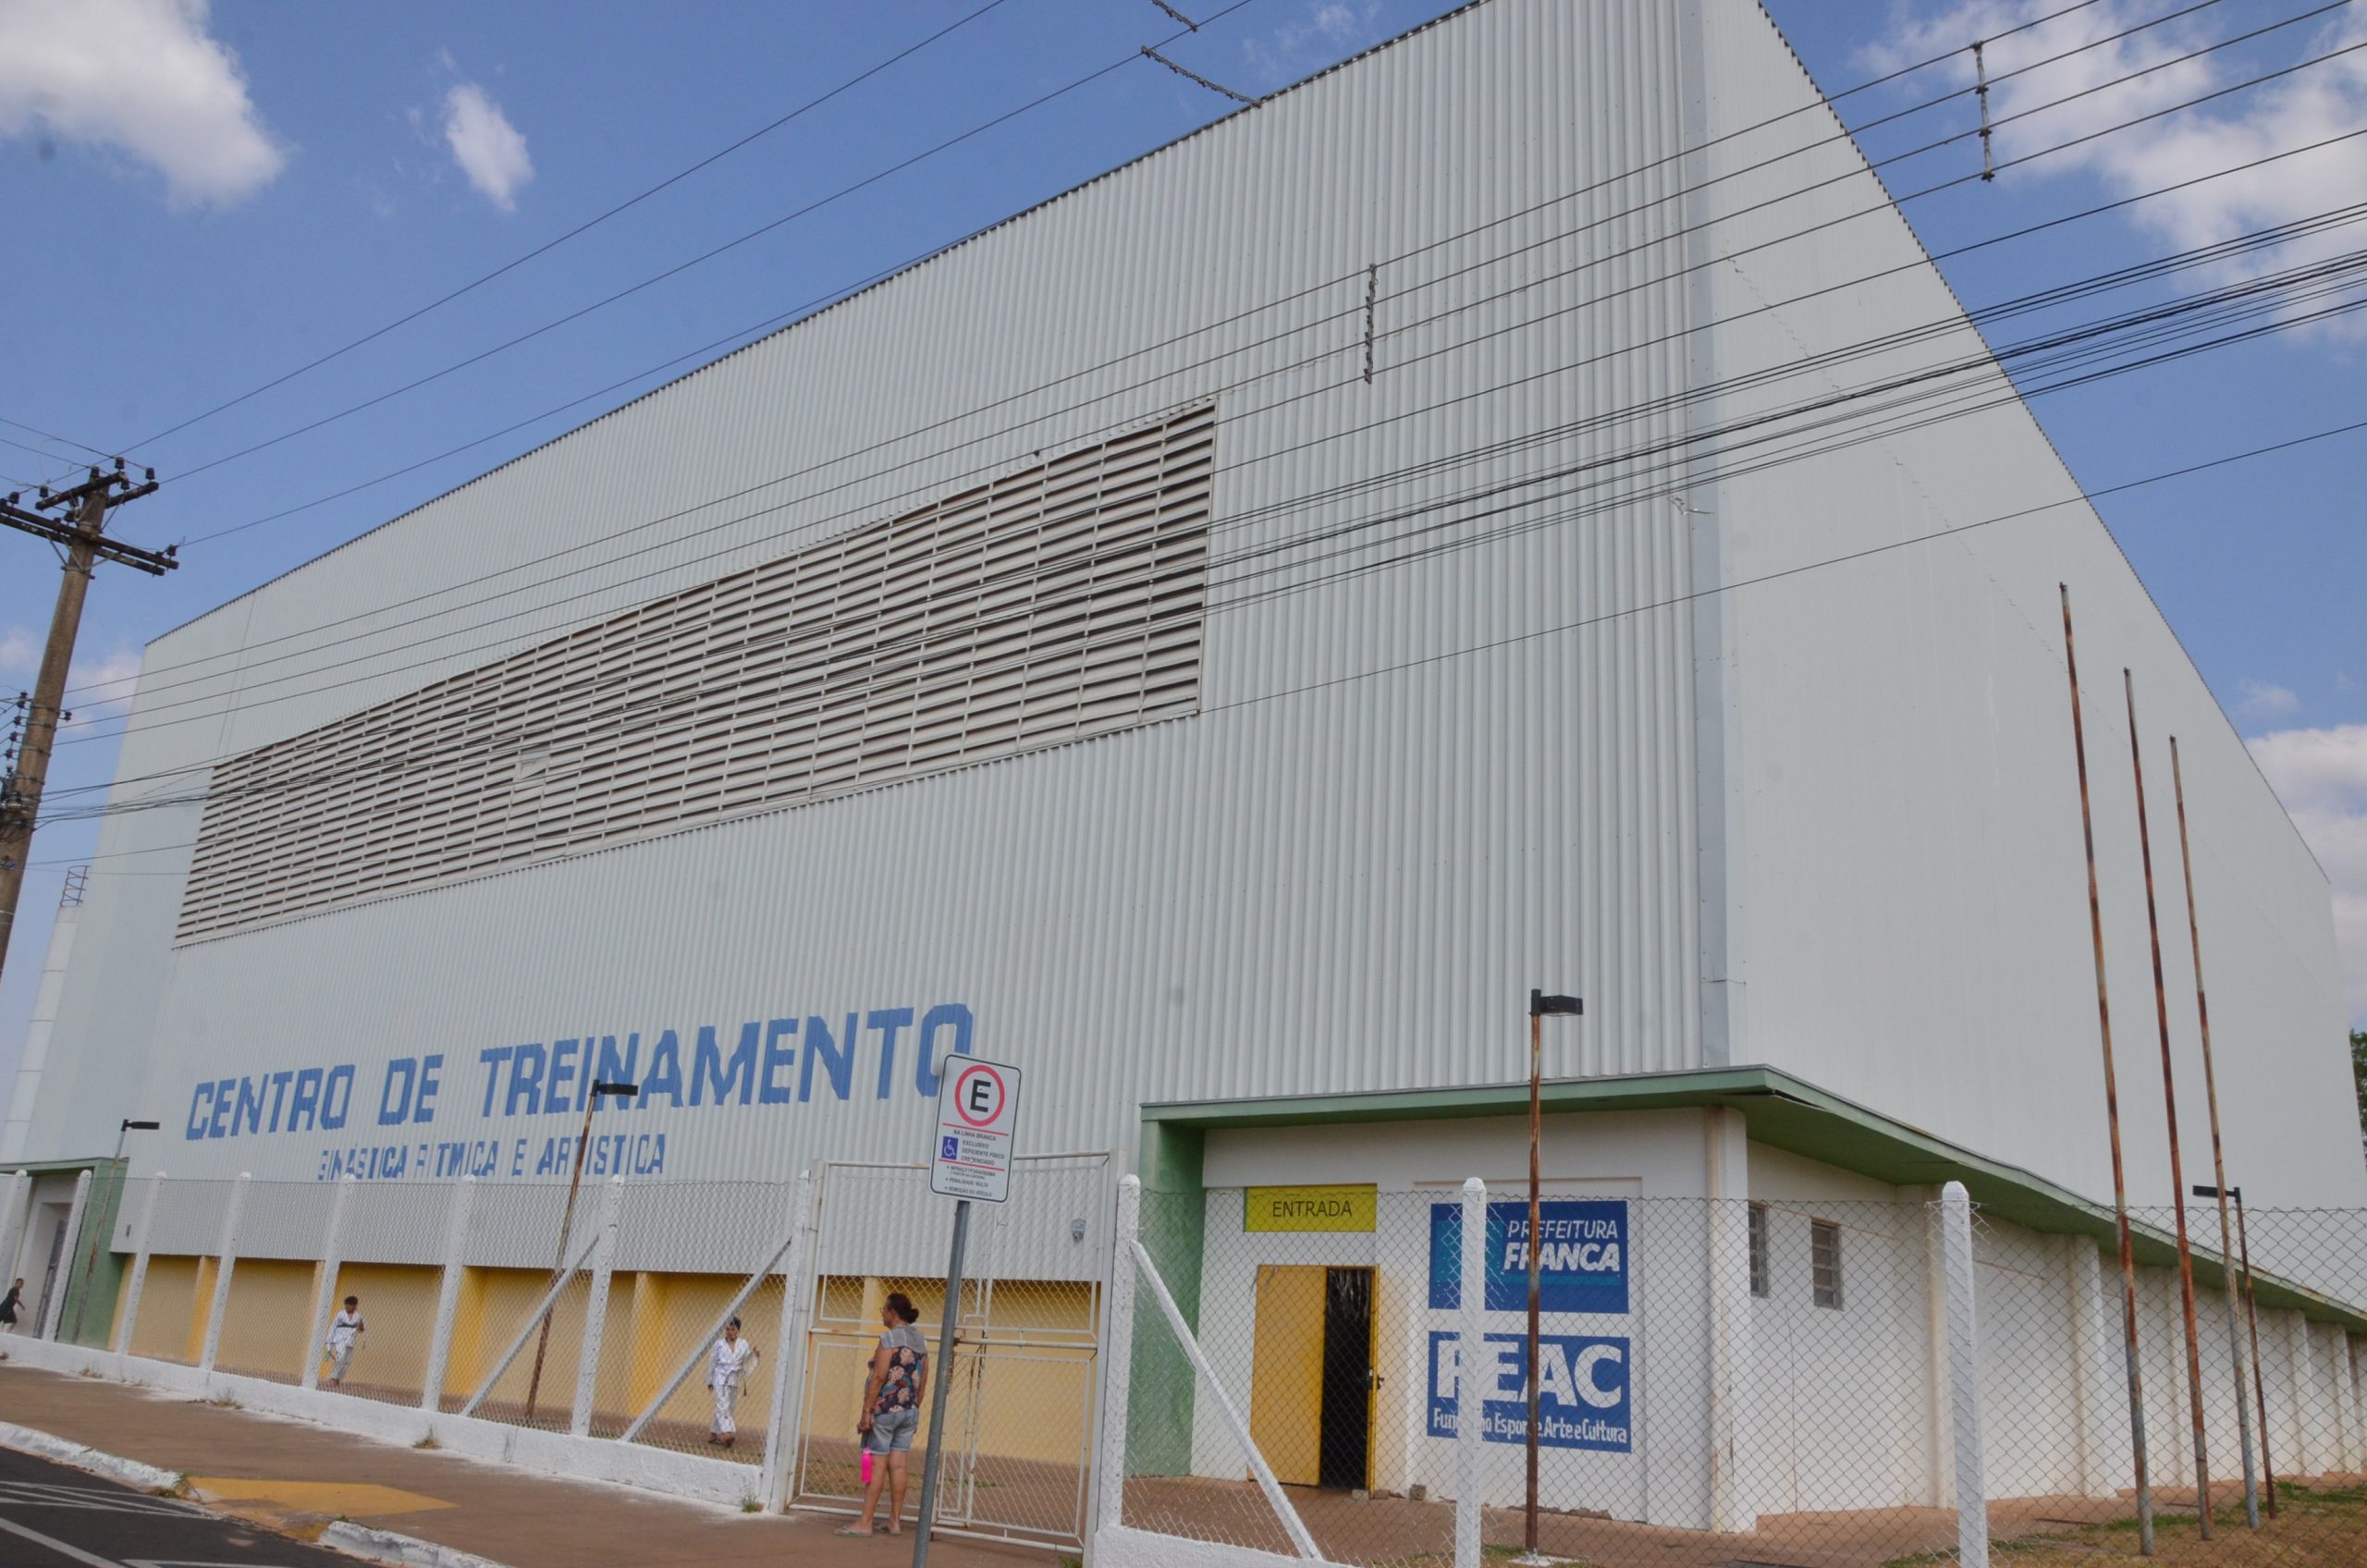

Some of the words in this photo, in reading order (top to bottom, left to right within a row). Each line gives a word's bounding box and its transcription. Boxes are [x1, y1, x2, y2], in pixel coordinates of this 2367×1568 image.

[186, 1064, 356, 1141] CENTRO
[378, 1054, 445, 1126] DE
[479, 1003, 975, 1117] TREINAMENTO
[970, 1079, 991, 1113] E
[511, 1139, 527, 1176] E
[962, 1140, 989, 1149] EXCLUSIVO
[962, 1147, 989, 1158] DEFICIENTE
[1272, 1200, 1353, 1218] ENTRADA
[1544, 1415, 1573, 1439] Arte
[1574, 1425, 1582, 1439] e
[1582, 1418, 1627, 1444] Cultura
